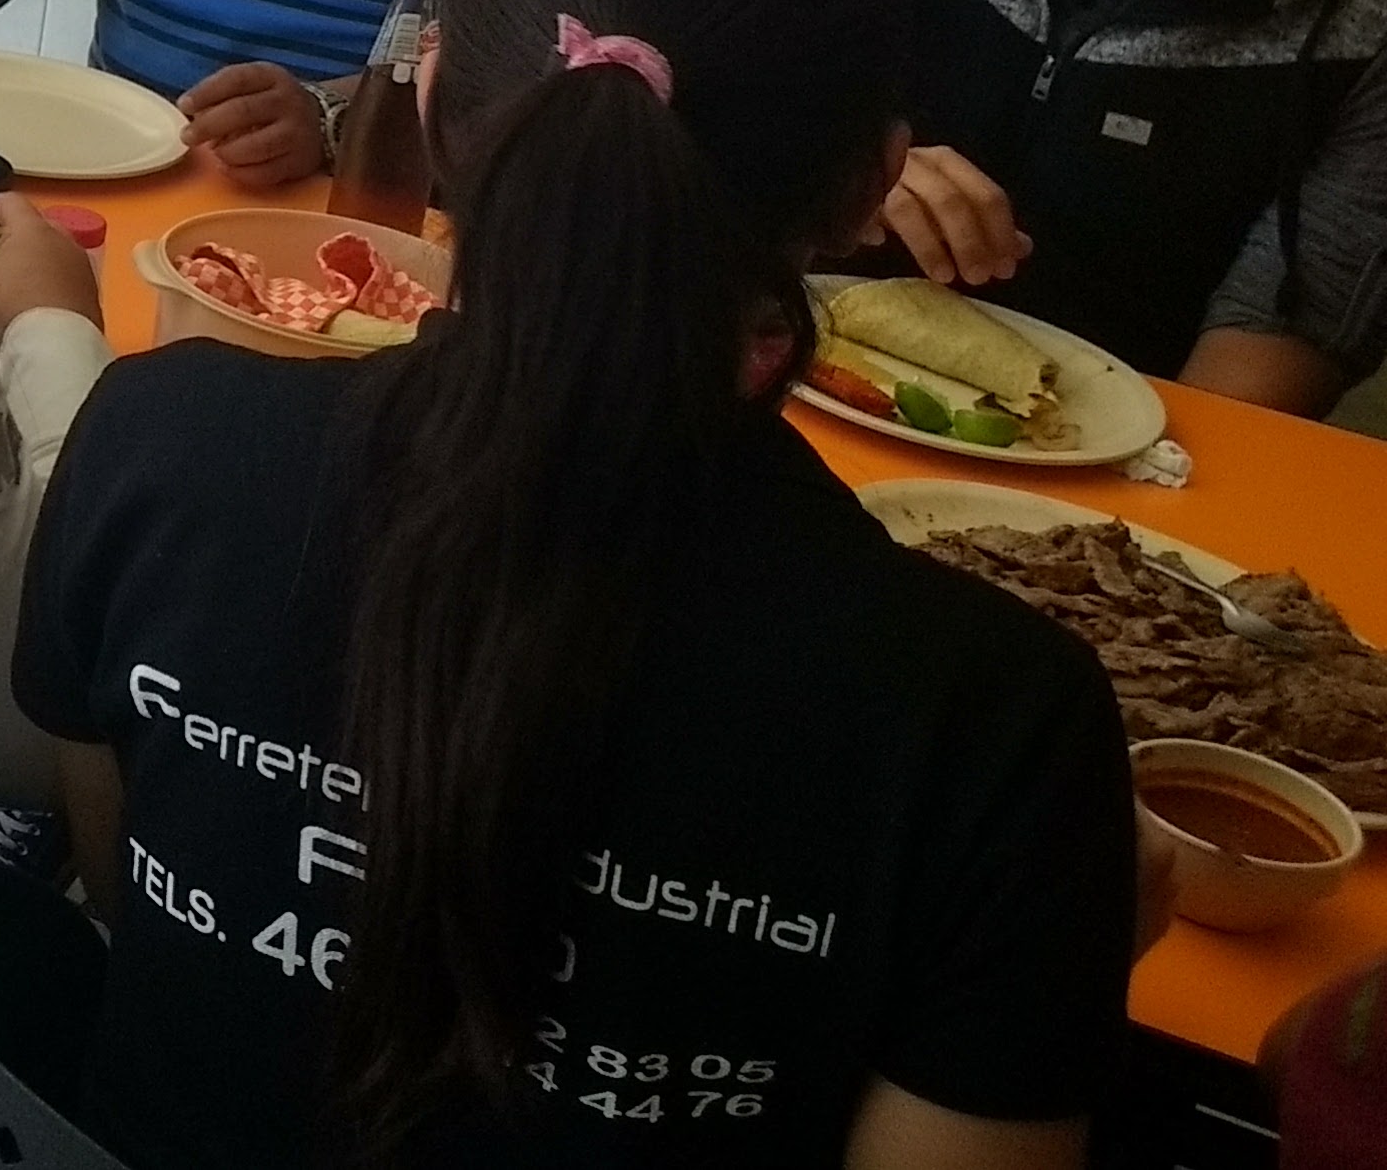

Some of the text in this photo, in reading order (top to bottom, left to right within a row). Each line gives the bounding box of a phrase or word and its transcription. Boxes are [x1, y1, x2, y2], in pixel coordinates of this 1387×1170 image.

[573, 849, 835, 957] dustrial
[128, 836, 226, 942] TELS.
[251, 910, 352, 990] 46
[586, 1044, 669, 1082] 83
[690, 1054, 776, 1083] 05
[578, 1090, 665, 1123] 44
[687, 1090, 763, 1118] 76
